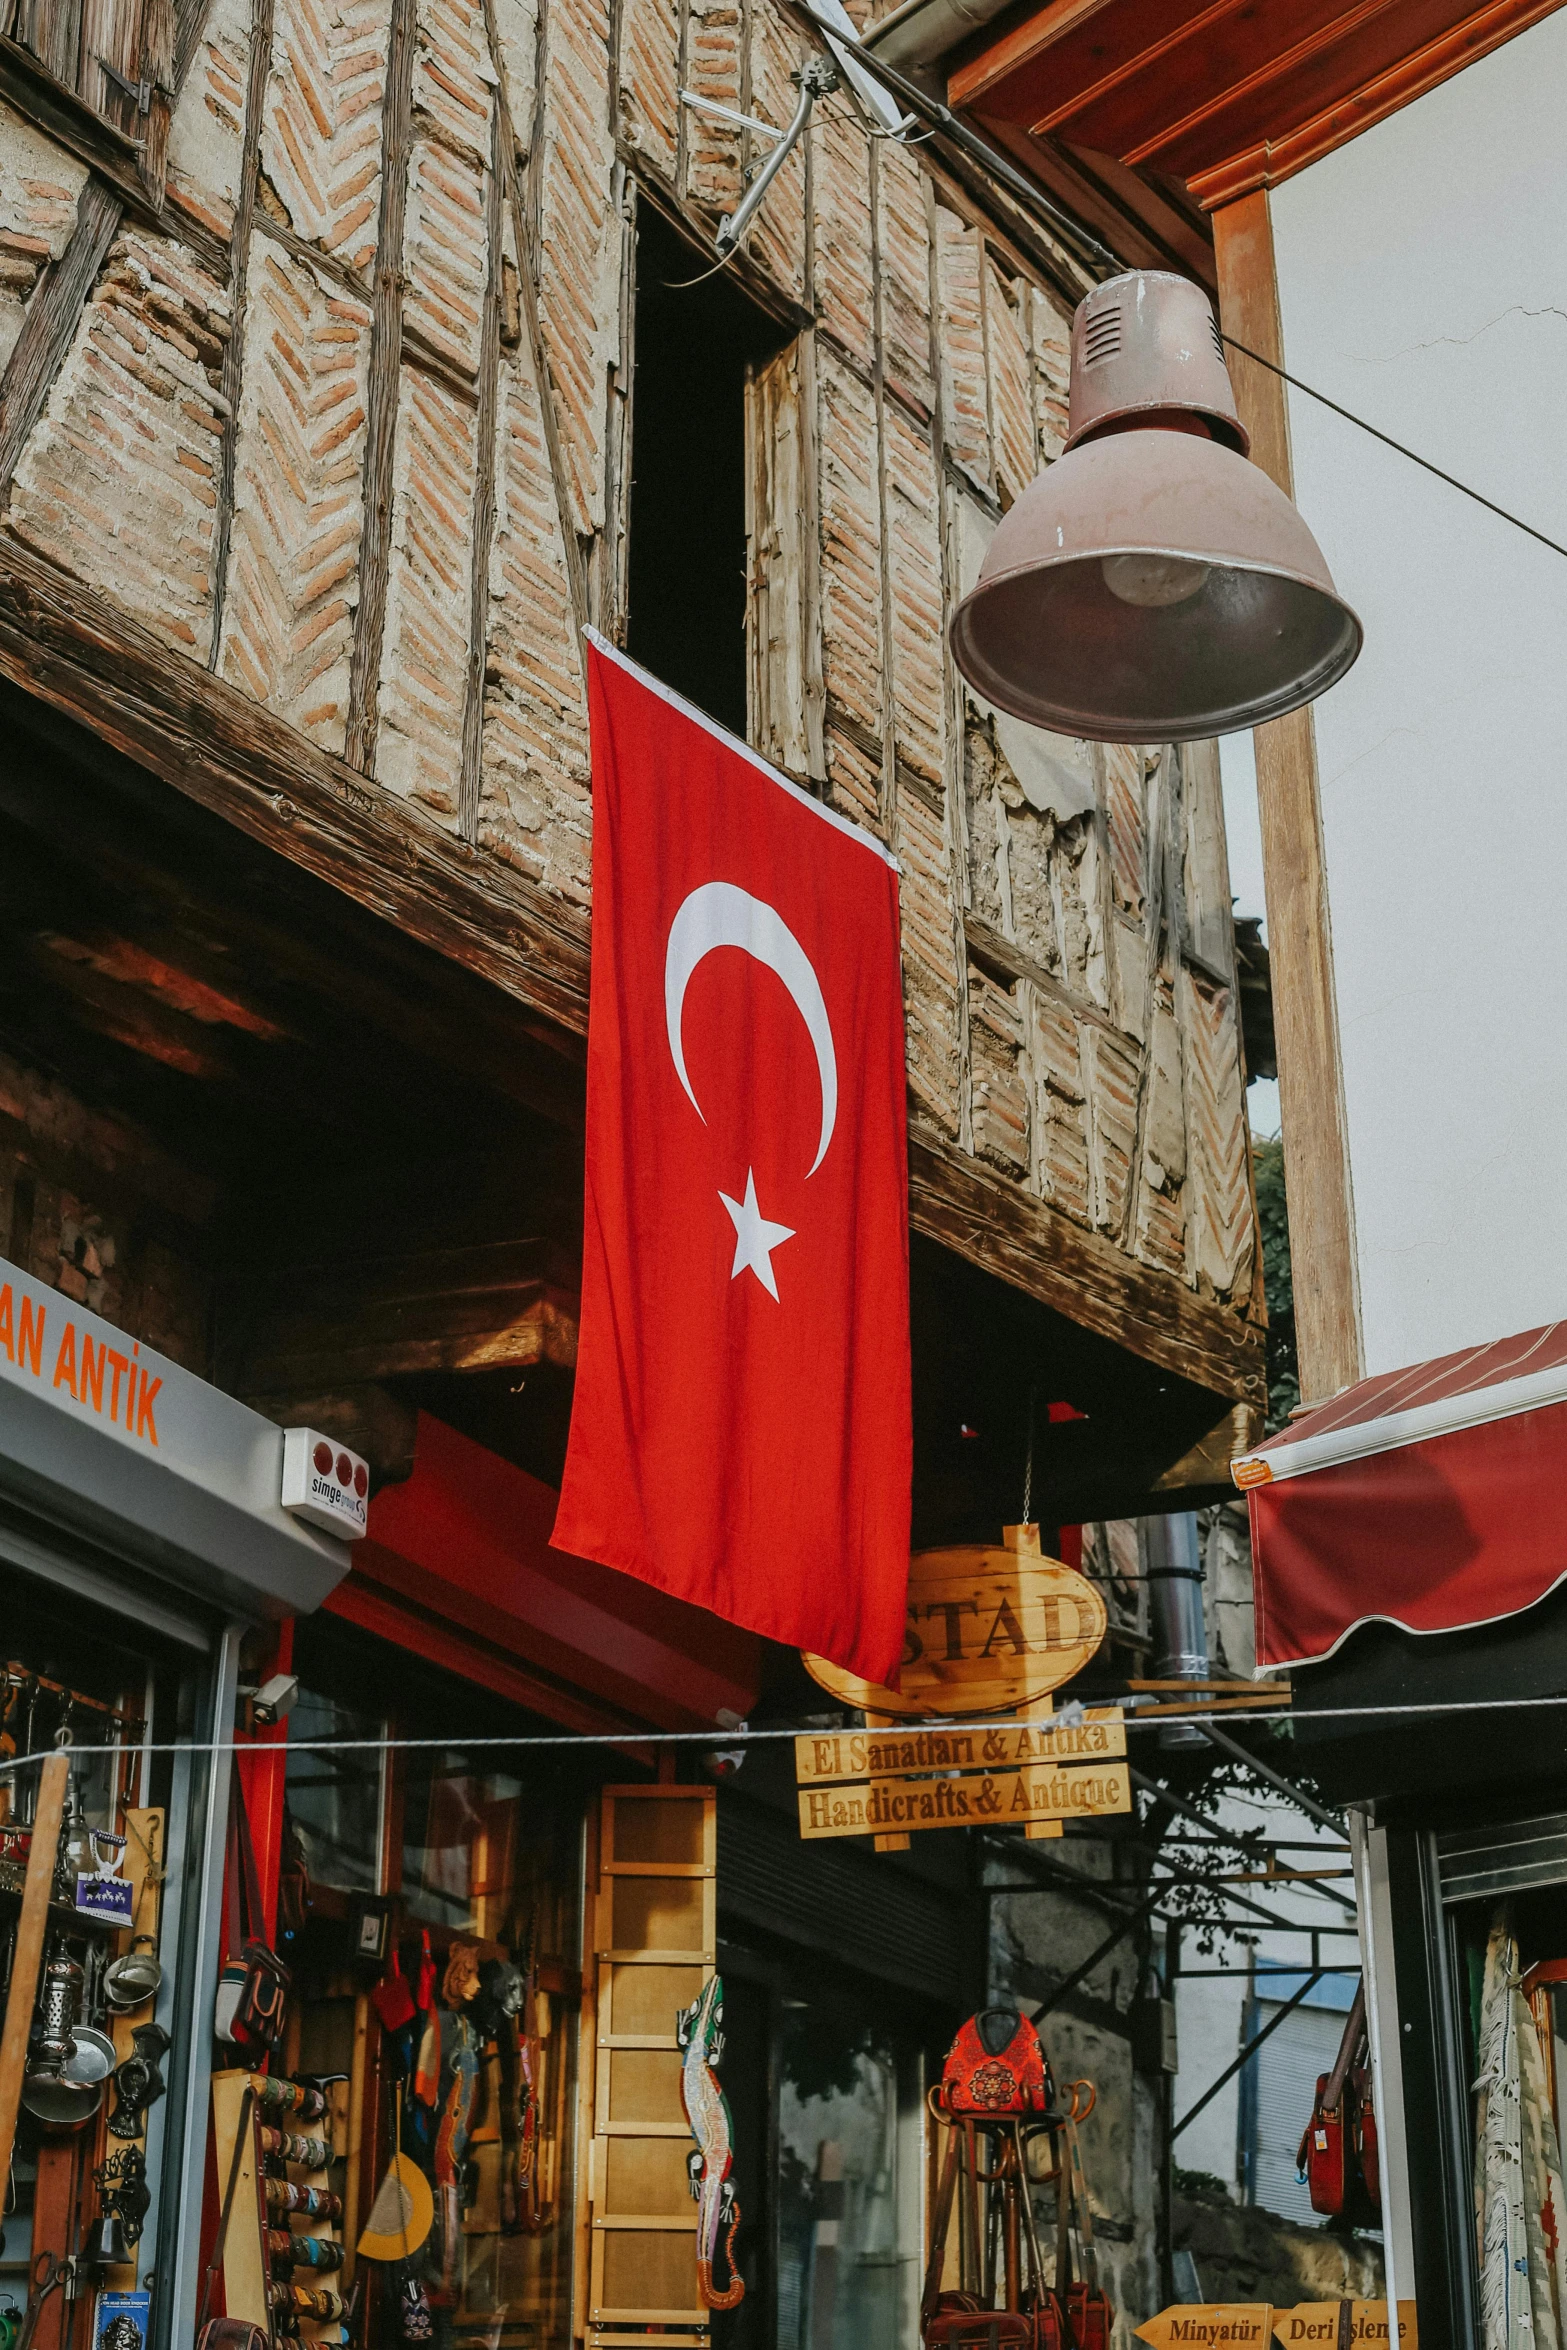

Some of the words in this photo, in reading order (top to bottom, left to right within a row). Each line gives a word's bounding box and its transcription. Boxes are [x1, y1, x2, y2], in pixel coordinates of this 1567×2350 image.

[53, 1322, 163, 1447] ANTİK
[312, 1476, 342, 1504] simge
[903, 1593, 1096, 1667] STAD
[811, 1738, 843, 1775] El
[850, 1731, 975, 1773] Sanatları
[982, 1728, 1008, 1762] &
[807, 1781, 969, 1829] Handicrafts
[974, 1778, 1002, 1815] &
[1010, 1771, 1120, 1813] Antique
[1168, 2319, 1262, 2347] Minyatür
[1289, 2317, 1333, 2340] Deri
[1350, 2317, 1407, 2345] şleme
